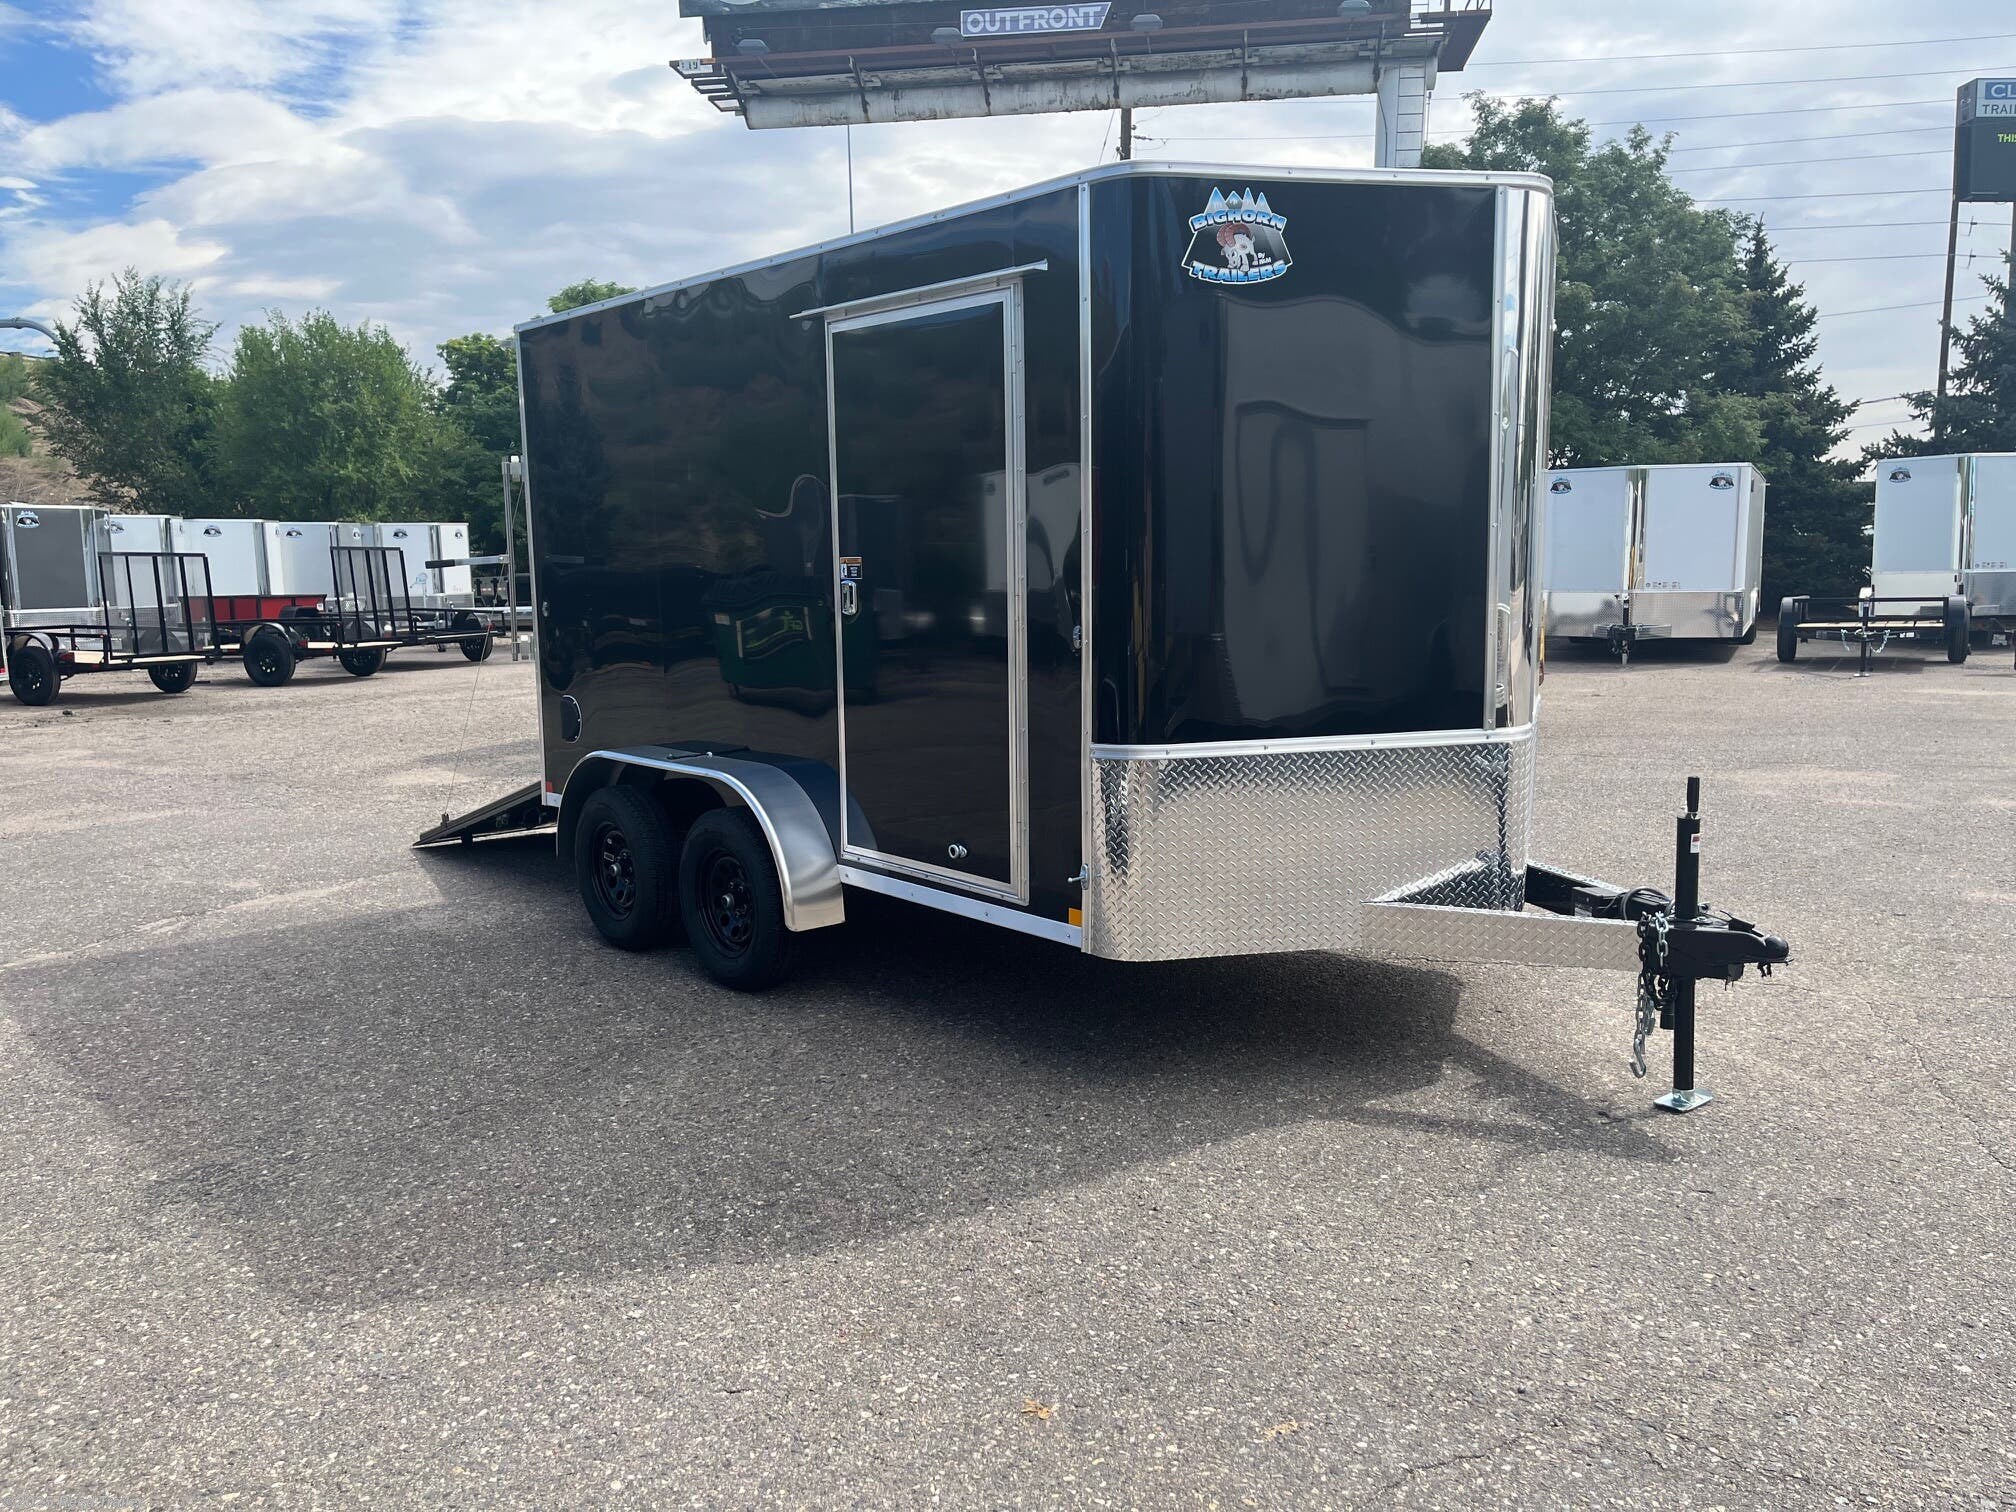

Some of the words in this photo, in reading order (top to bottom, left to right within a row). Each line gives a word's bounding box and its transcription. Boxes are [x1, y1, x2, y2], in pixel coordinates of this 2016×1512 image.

[967, 6, 1102, 33] OUTFRONT
[1982, 104, 2016, 114] TRAI
[1191, 209, 1287, 231] BIGHORN
[1191, 260, 1288, 281] TRAILERS
